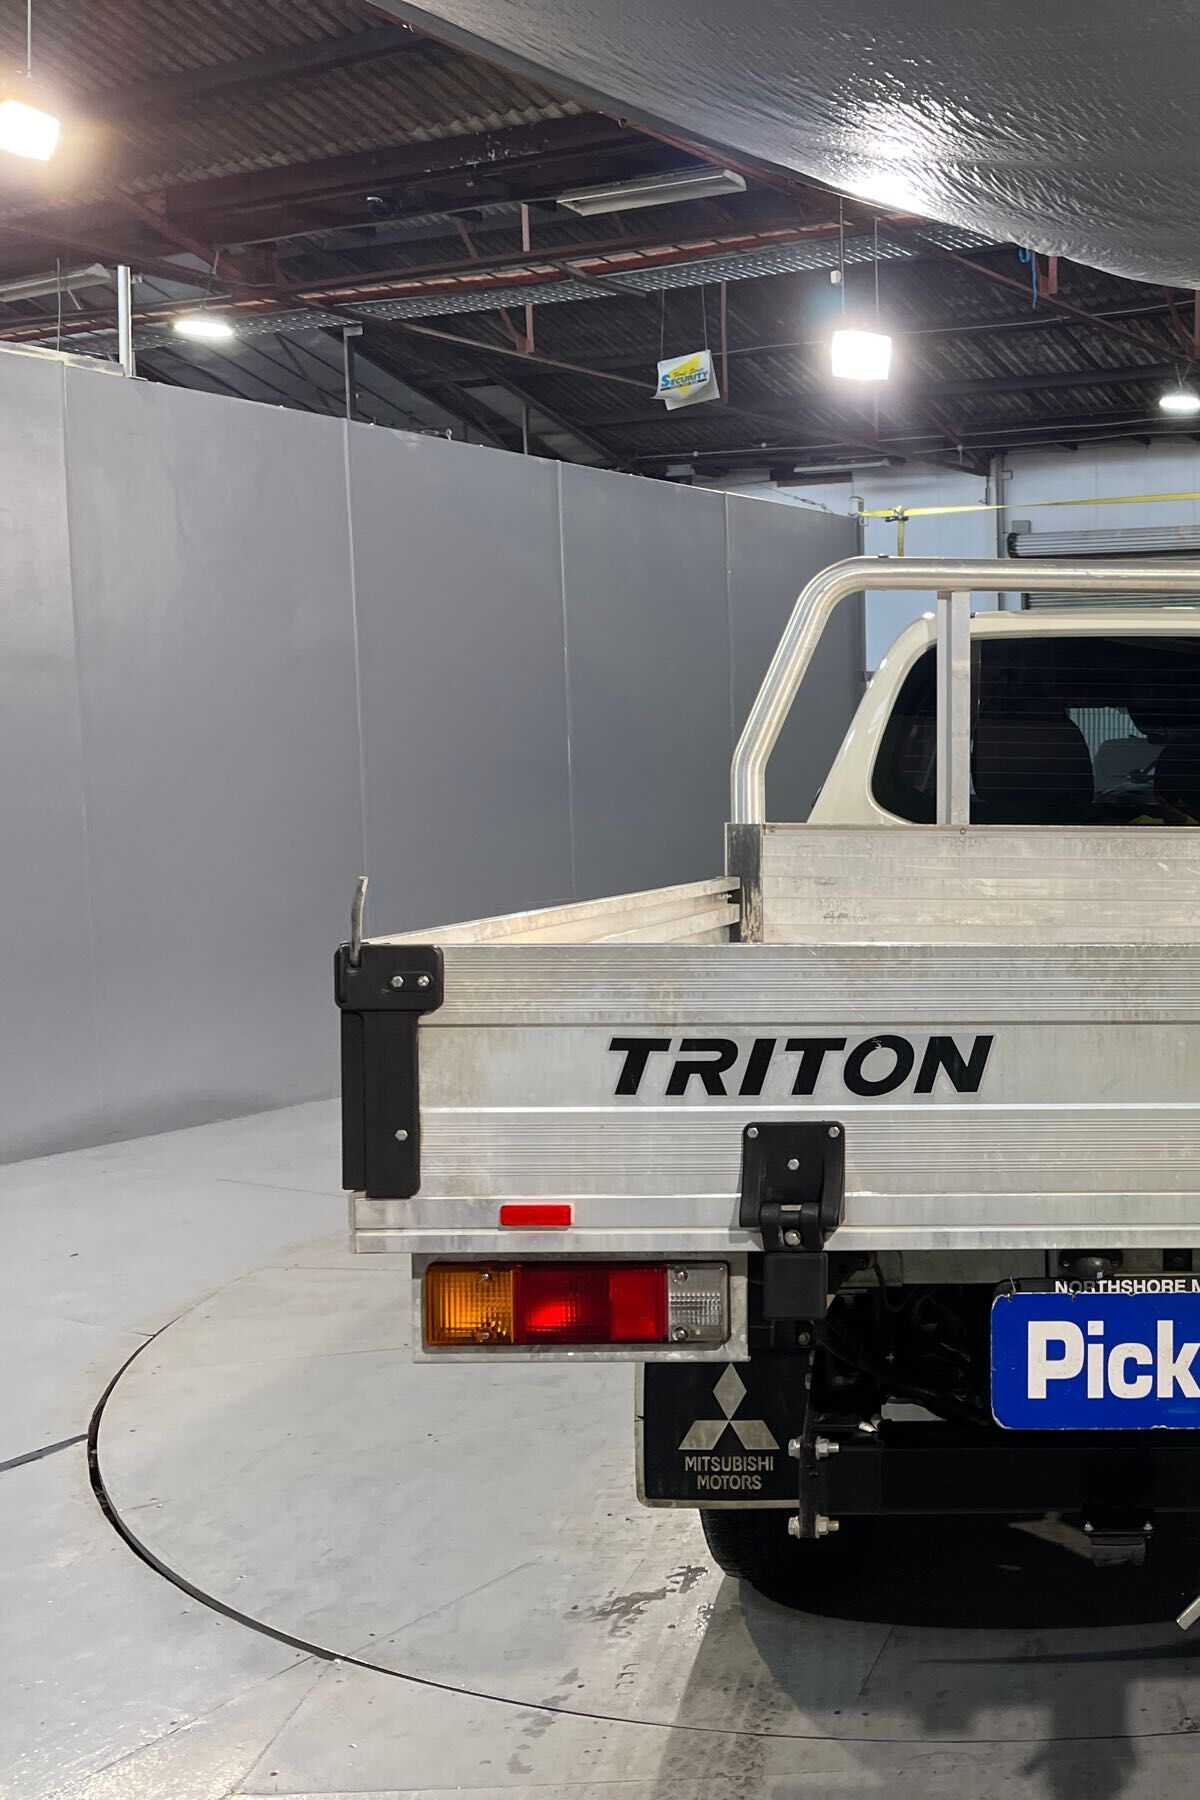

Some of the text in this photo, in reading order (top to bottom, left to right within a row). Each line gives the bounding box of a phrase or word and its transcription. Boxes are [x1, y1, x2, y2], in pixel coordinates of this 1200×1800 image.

[608, 1034, 995, 1097] TRITON
[1054, 1279, 1186, 1293] NORTHSHORE
[684, 1456, 774, 1472] MITSUBISHI
[697, 1475, 762, 1490] MOTORS
